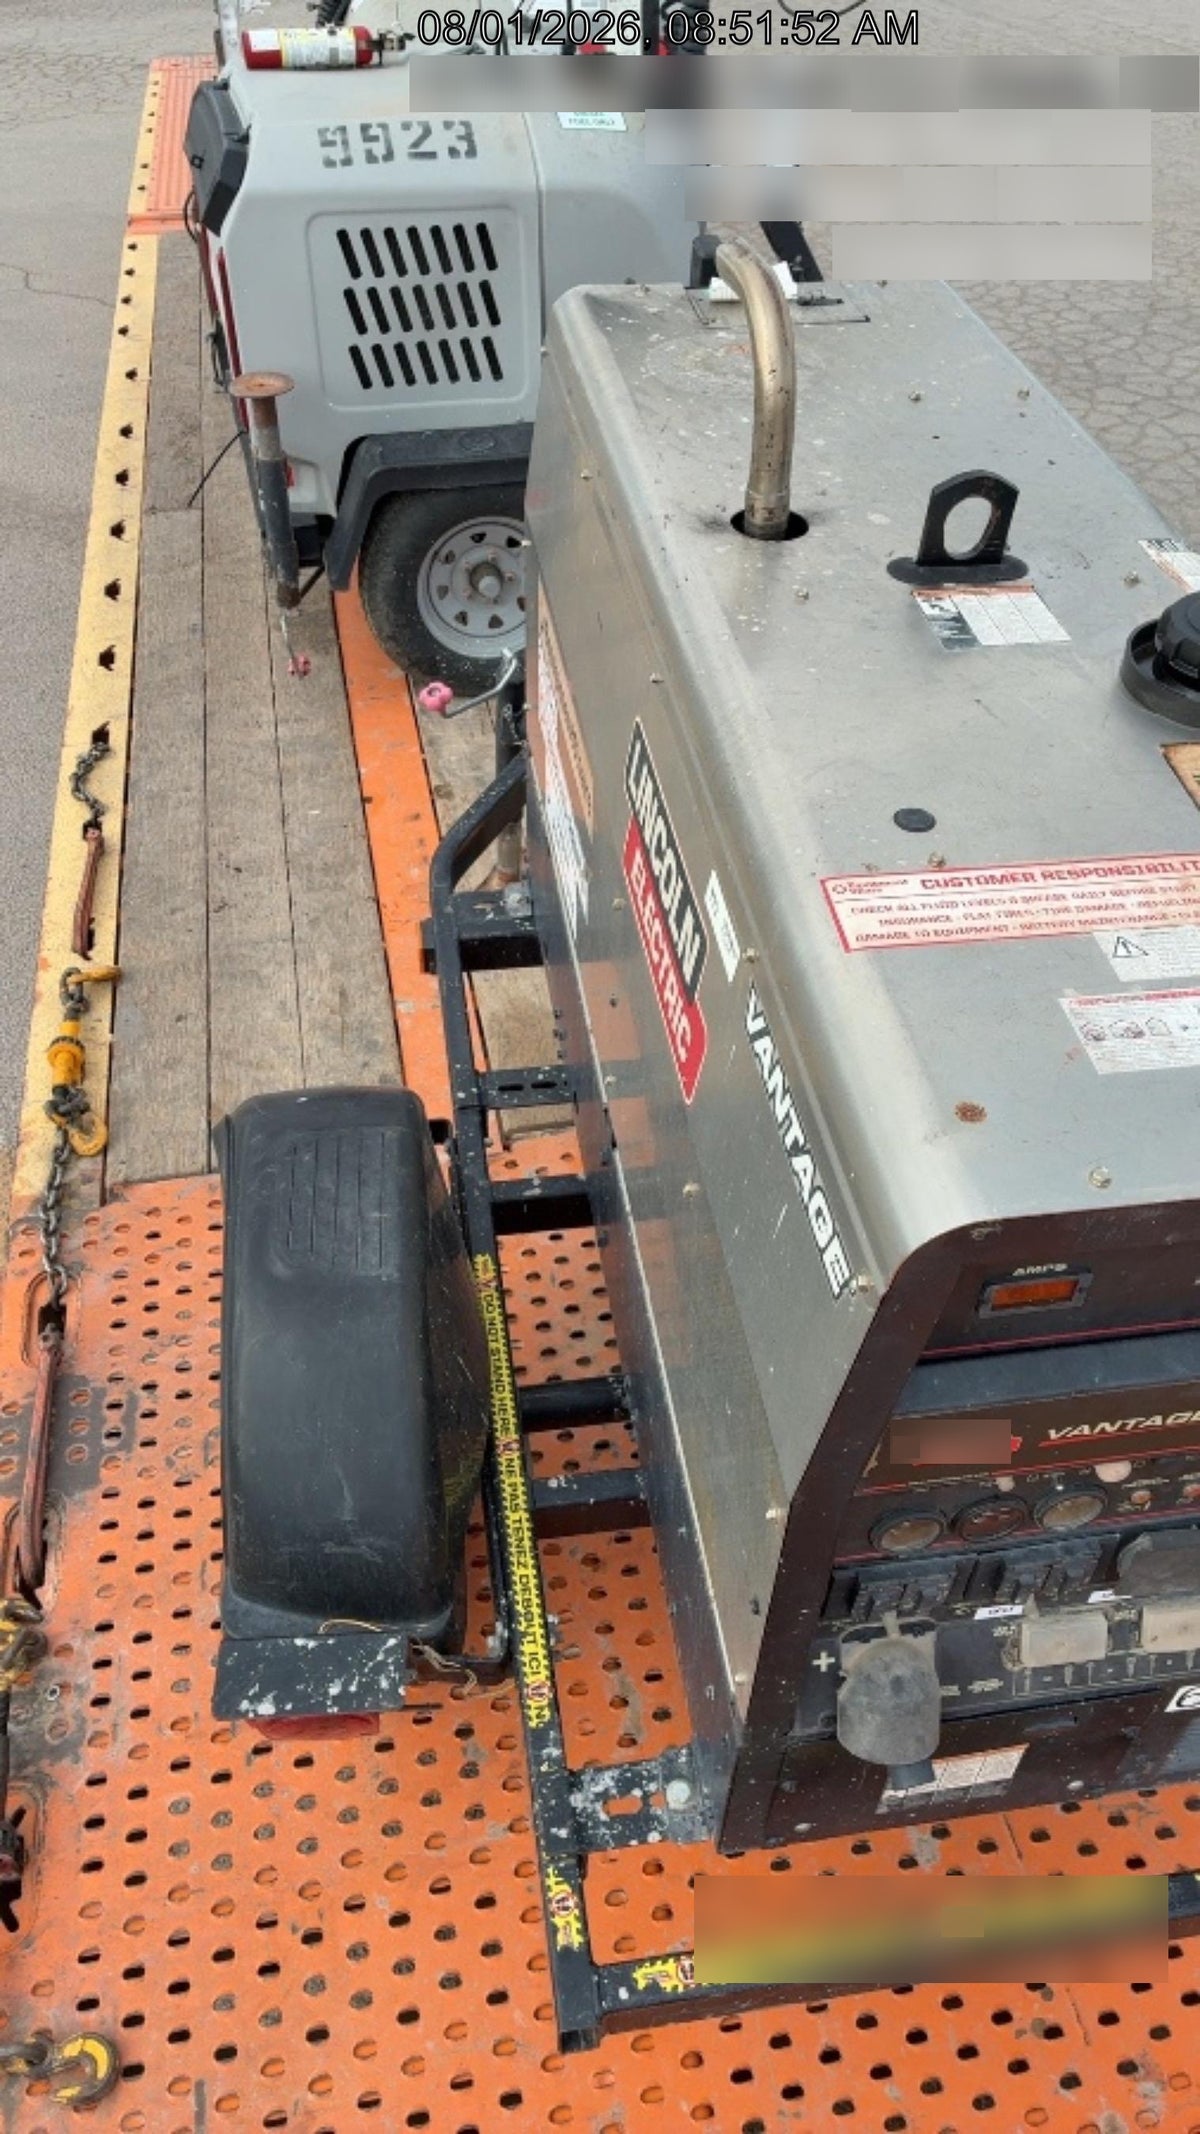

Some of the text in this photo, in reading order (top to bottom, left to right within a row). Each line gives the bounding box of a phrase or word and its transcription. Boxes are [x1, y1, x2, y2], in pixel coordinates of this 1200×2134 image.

[317, 120, 478, 168] 9923
[628, 739, 701, 986] LINCOLN
[920, 872, 1037, 890] CUSTOMER
[631, 848, 692, 1063] ELECTRIC
[746, 980, 851, 1299] VANTAGE
[1012, 1262, 1069, 1277] AMPS
[486, 1320, 500, 1343] NOT
[490, 1347, 507, 1395] STAND
[508, 1485, 522, 1514] PAS
[512, 1516, 529, 1571] TENEZ
[528, 1652, 542, 1676] ICI
